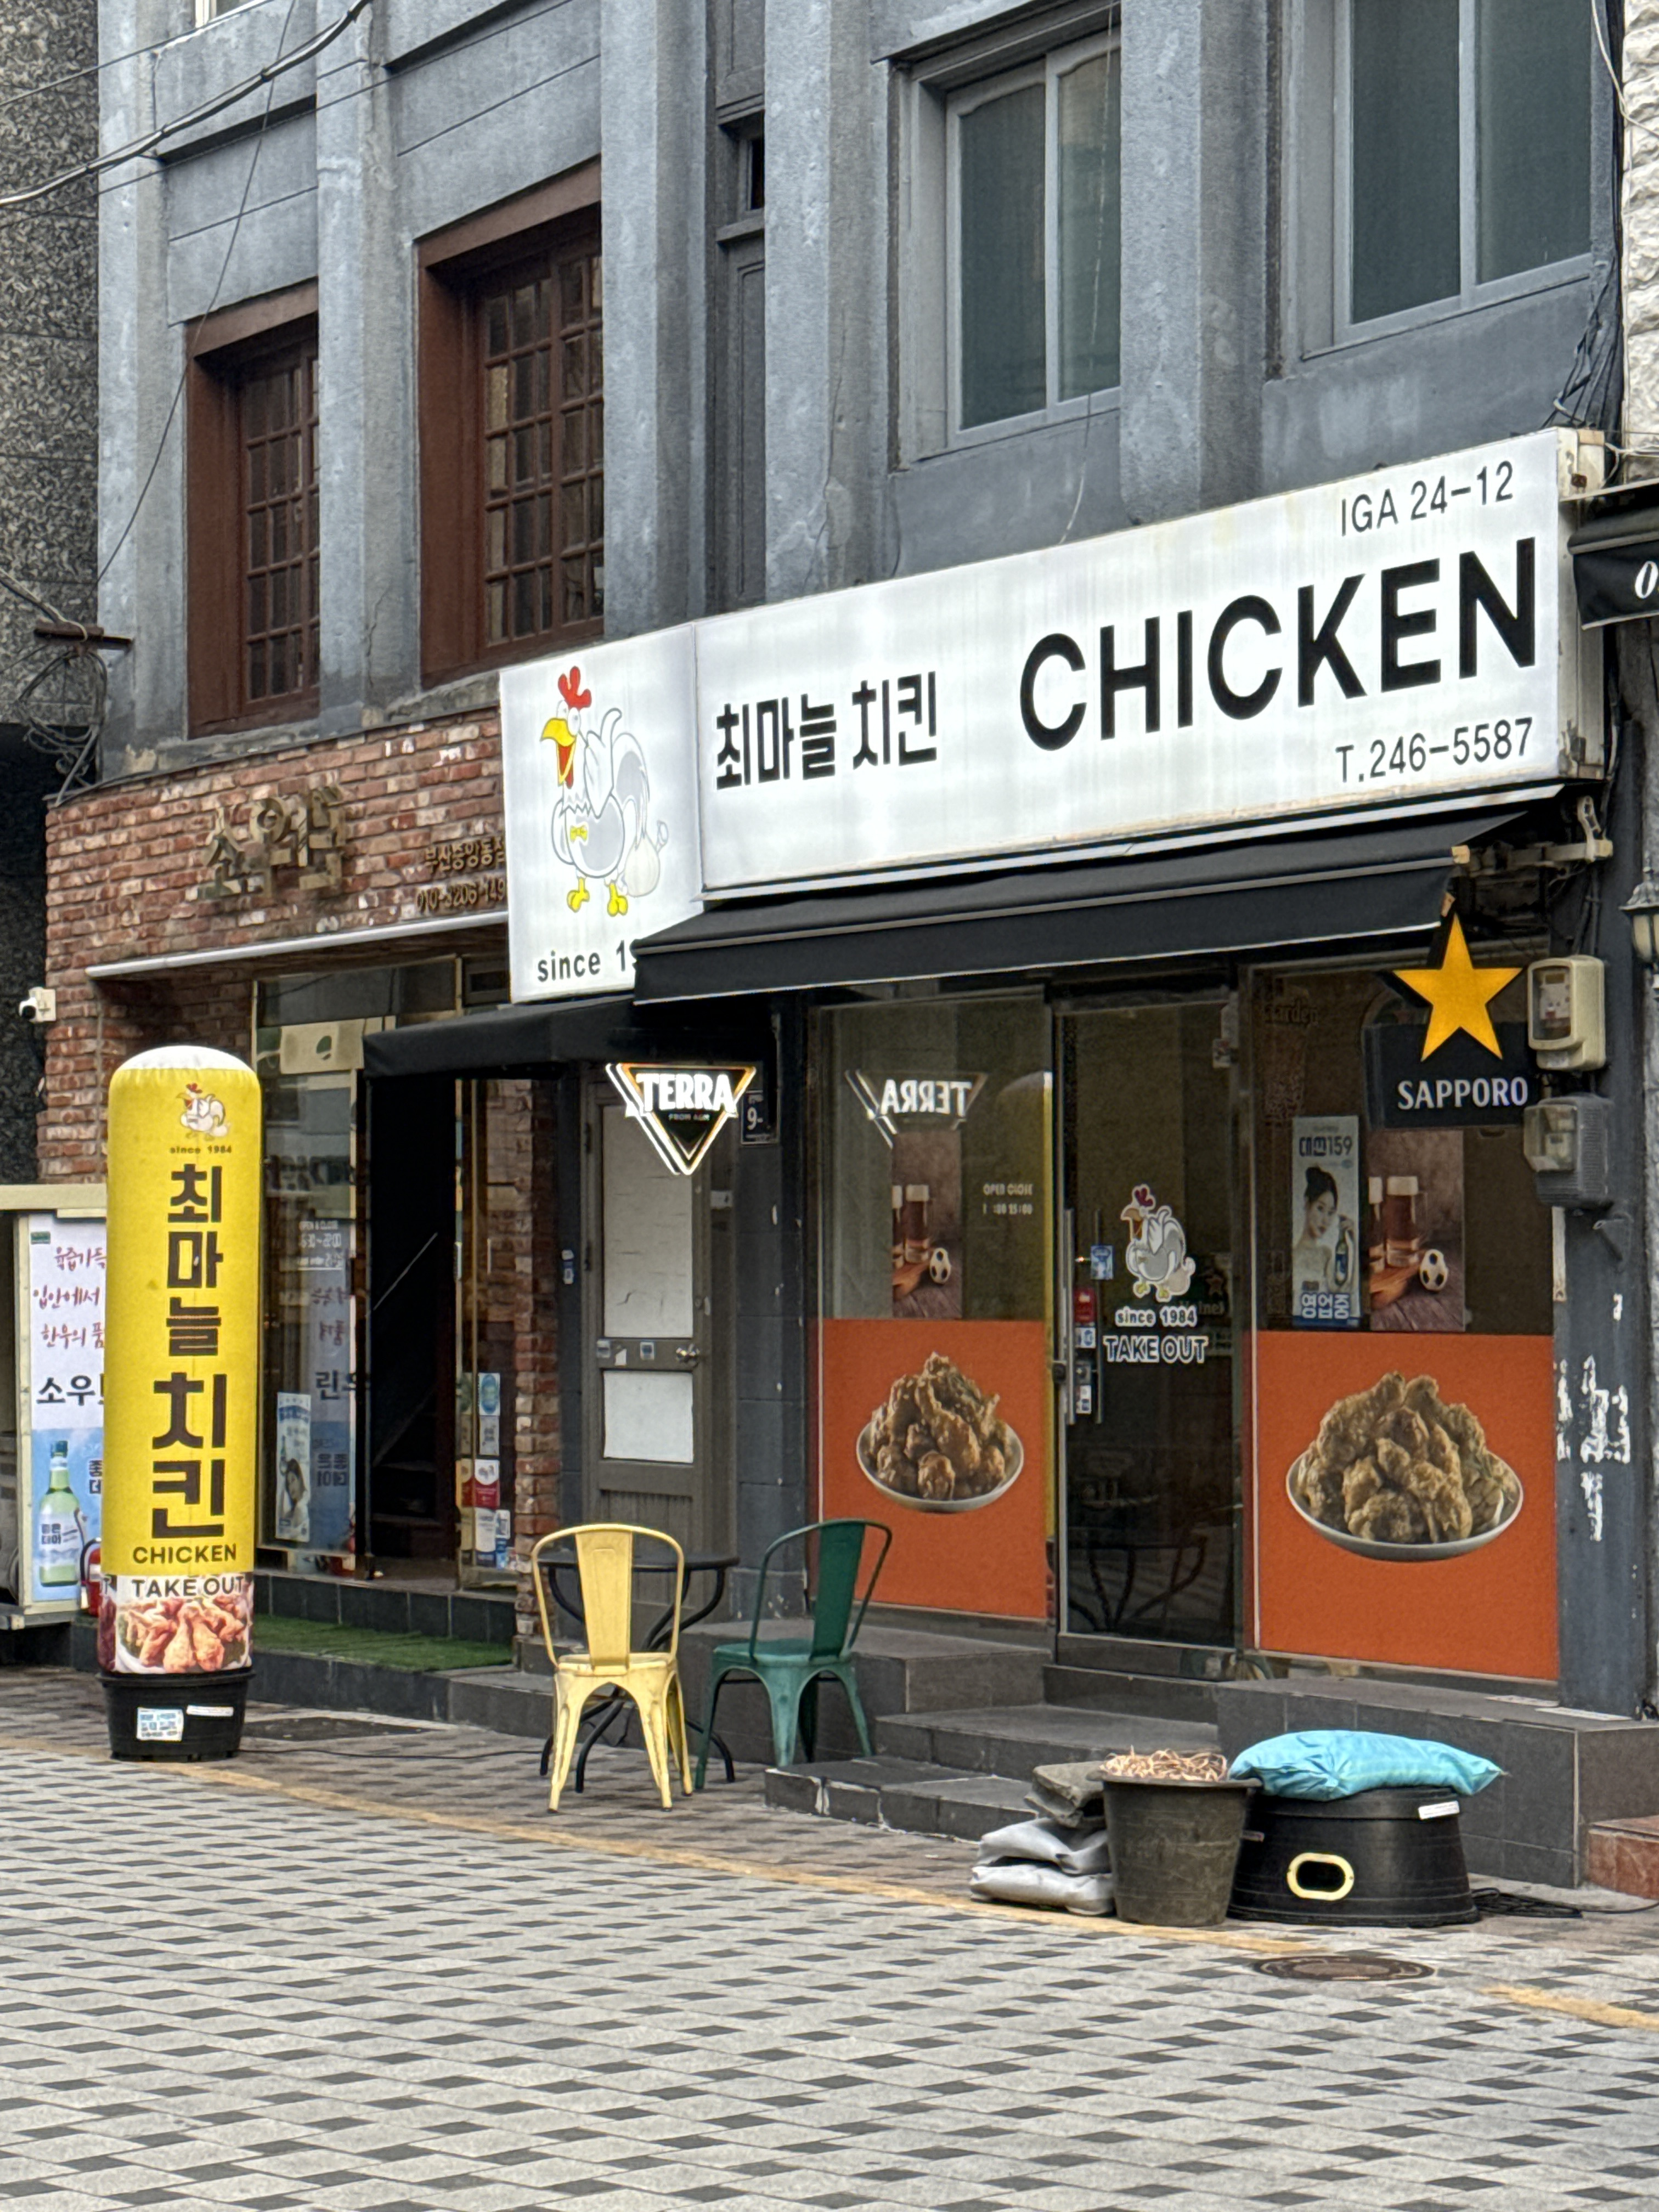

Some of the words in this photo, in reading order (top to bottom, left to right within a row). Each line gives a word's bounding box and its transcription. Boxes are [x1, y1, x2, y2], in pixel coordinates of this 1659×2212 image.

[1341, 488, 1398, 537] IGA
[1410, 461, 1513, 521] 24-12
[1020, 537, 1536, 751] CHICKEN
[716, 693, 837, 790] 최마늘
[852, 671, 937, 769] 치킨
[1336, 716, 1533, 783] T.246-5587
[538, 950, 601, 983] since
[635, 1073, 735, 1114] TERRA
[1398, 1077, 1528, 1111] SAPPORO
[170, 1146, 201, 1155] since
[207, 1145, 233, 1154] 1984
[983, 1183, 1006, 1195] OPEN
[1007, 1183, 1034, 1195] CLOSE
[166, 1164, 224, 1356] 최마늘
[33, 1284, 100, 1310] 입안에서
[1116, 1307, 1156, 1327] since
[1160, 1306, 1197, 1327] 1984
[41, 1323, 86, 1350] 한우의
[1103, 1335, 1160, 1363] TAKE
[1161, 1335, 1209, 1364] OUT
[152, 1372, 225, 1538] 치킨
[132, 1543, 236, 1564] CHICKEN
[132, 1579, 197, 1598] TAKE
[203, 1576, 244, 1595] OUT
